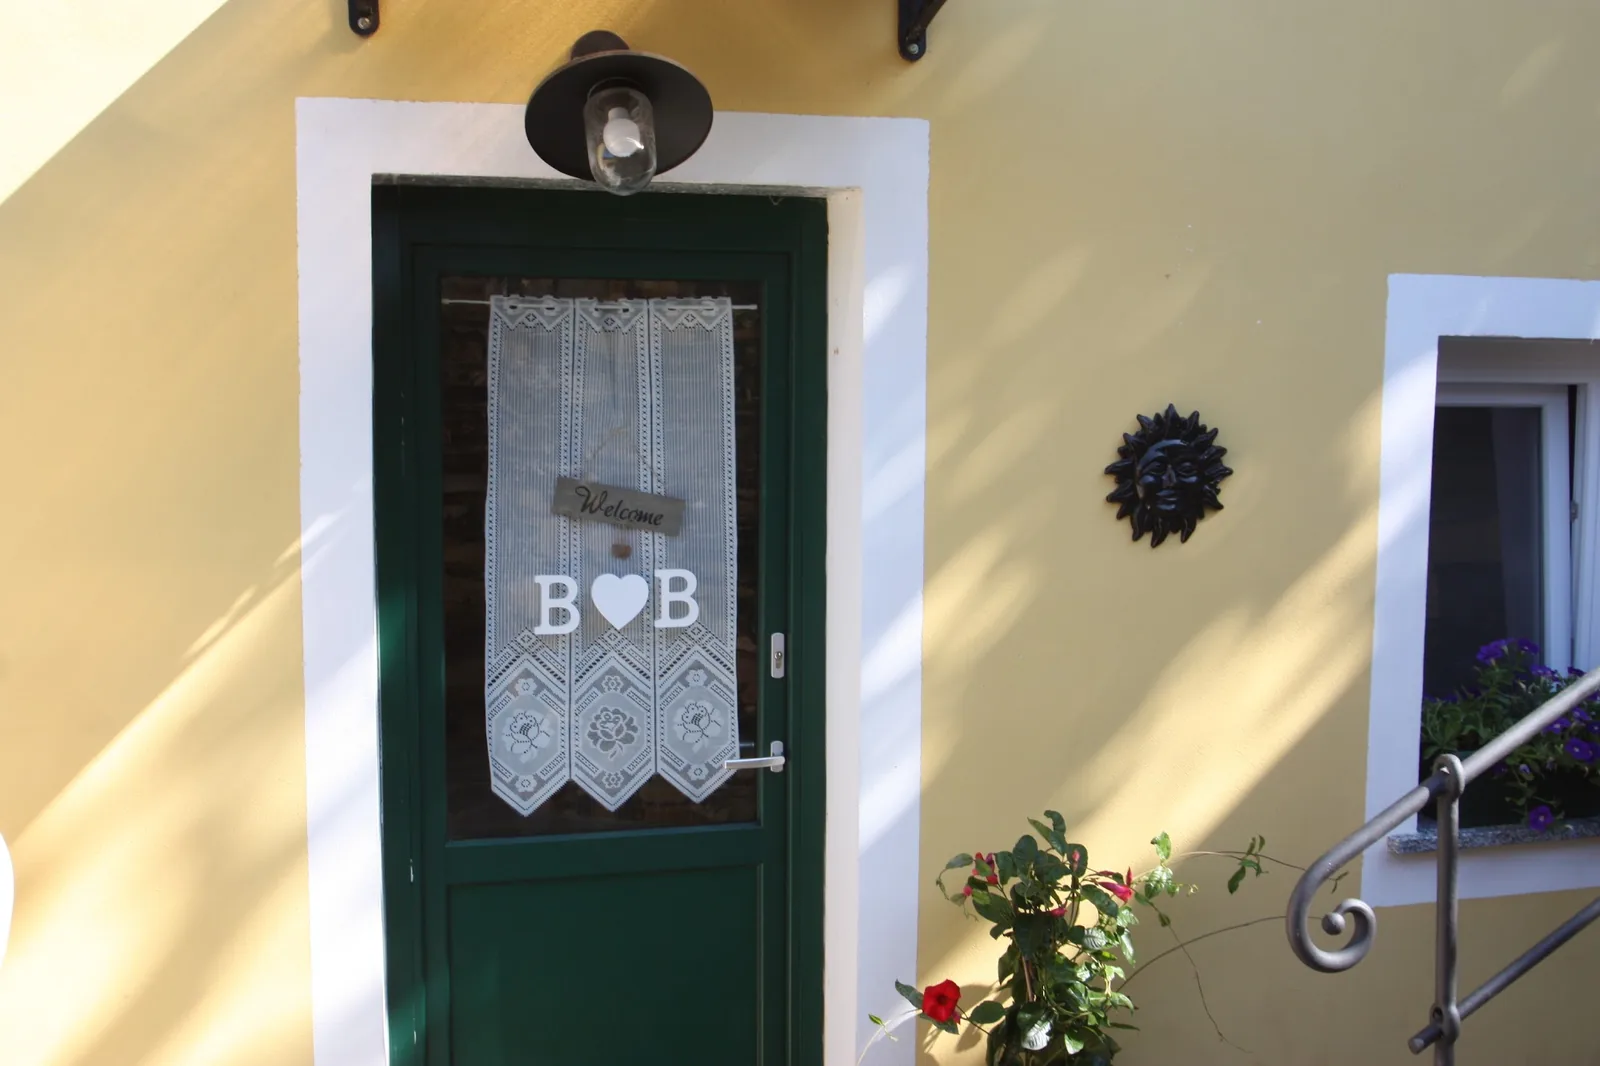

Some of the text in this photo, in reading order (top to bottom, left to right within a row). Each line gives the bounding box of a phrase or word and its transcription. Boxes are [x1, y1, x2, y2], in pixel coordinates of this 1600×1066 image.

[574, 485, 664, 526] Welcome
[534, 568, 699, 635] B B
